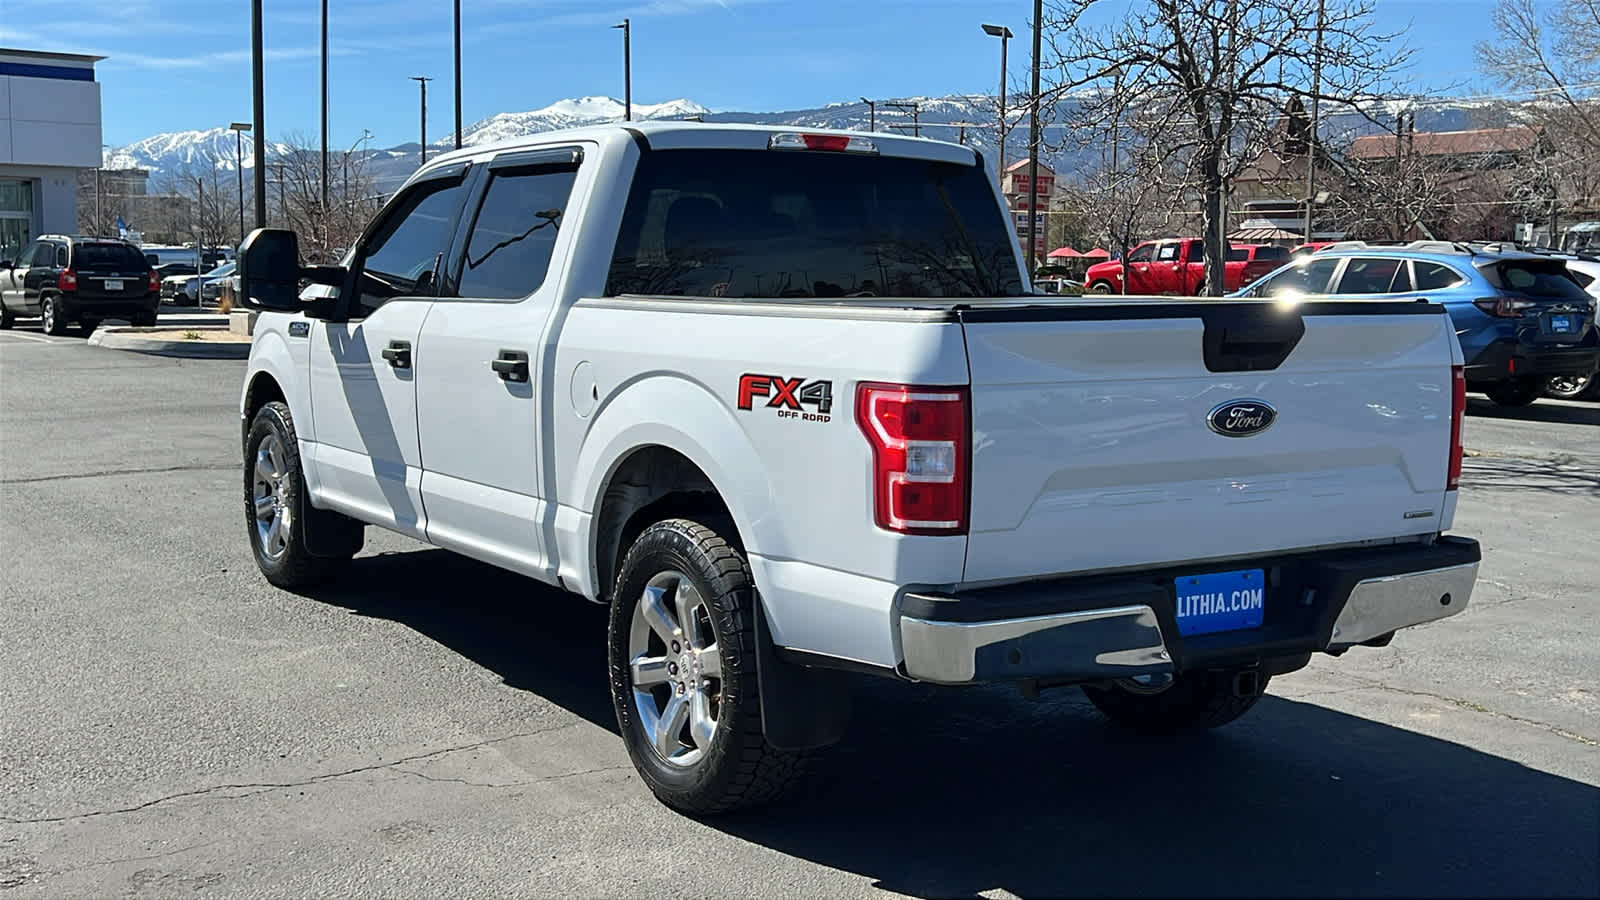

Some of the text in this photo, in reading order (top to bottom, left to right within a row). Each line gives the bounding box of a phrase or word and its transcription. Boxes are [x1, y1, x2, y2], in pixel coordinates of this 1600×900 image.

[737, 373, 833, 414] FX4
[777, 410, 831, 423] OFF ROAD
[1226, 407, 1264, 429] Ford
[1177, 588, 1262, 617] LITHIA.COM
